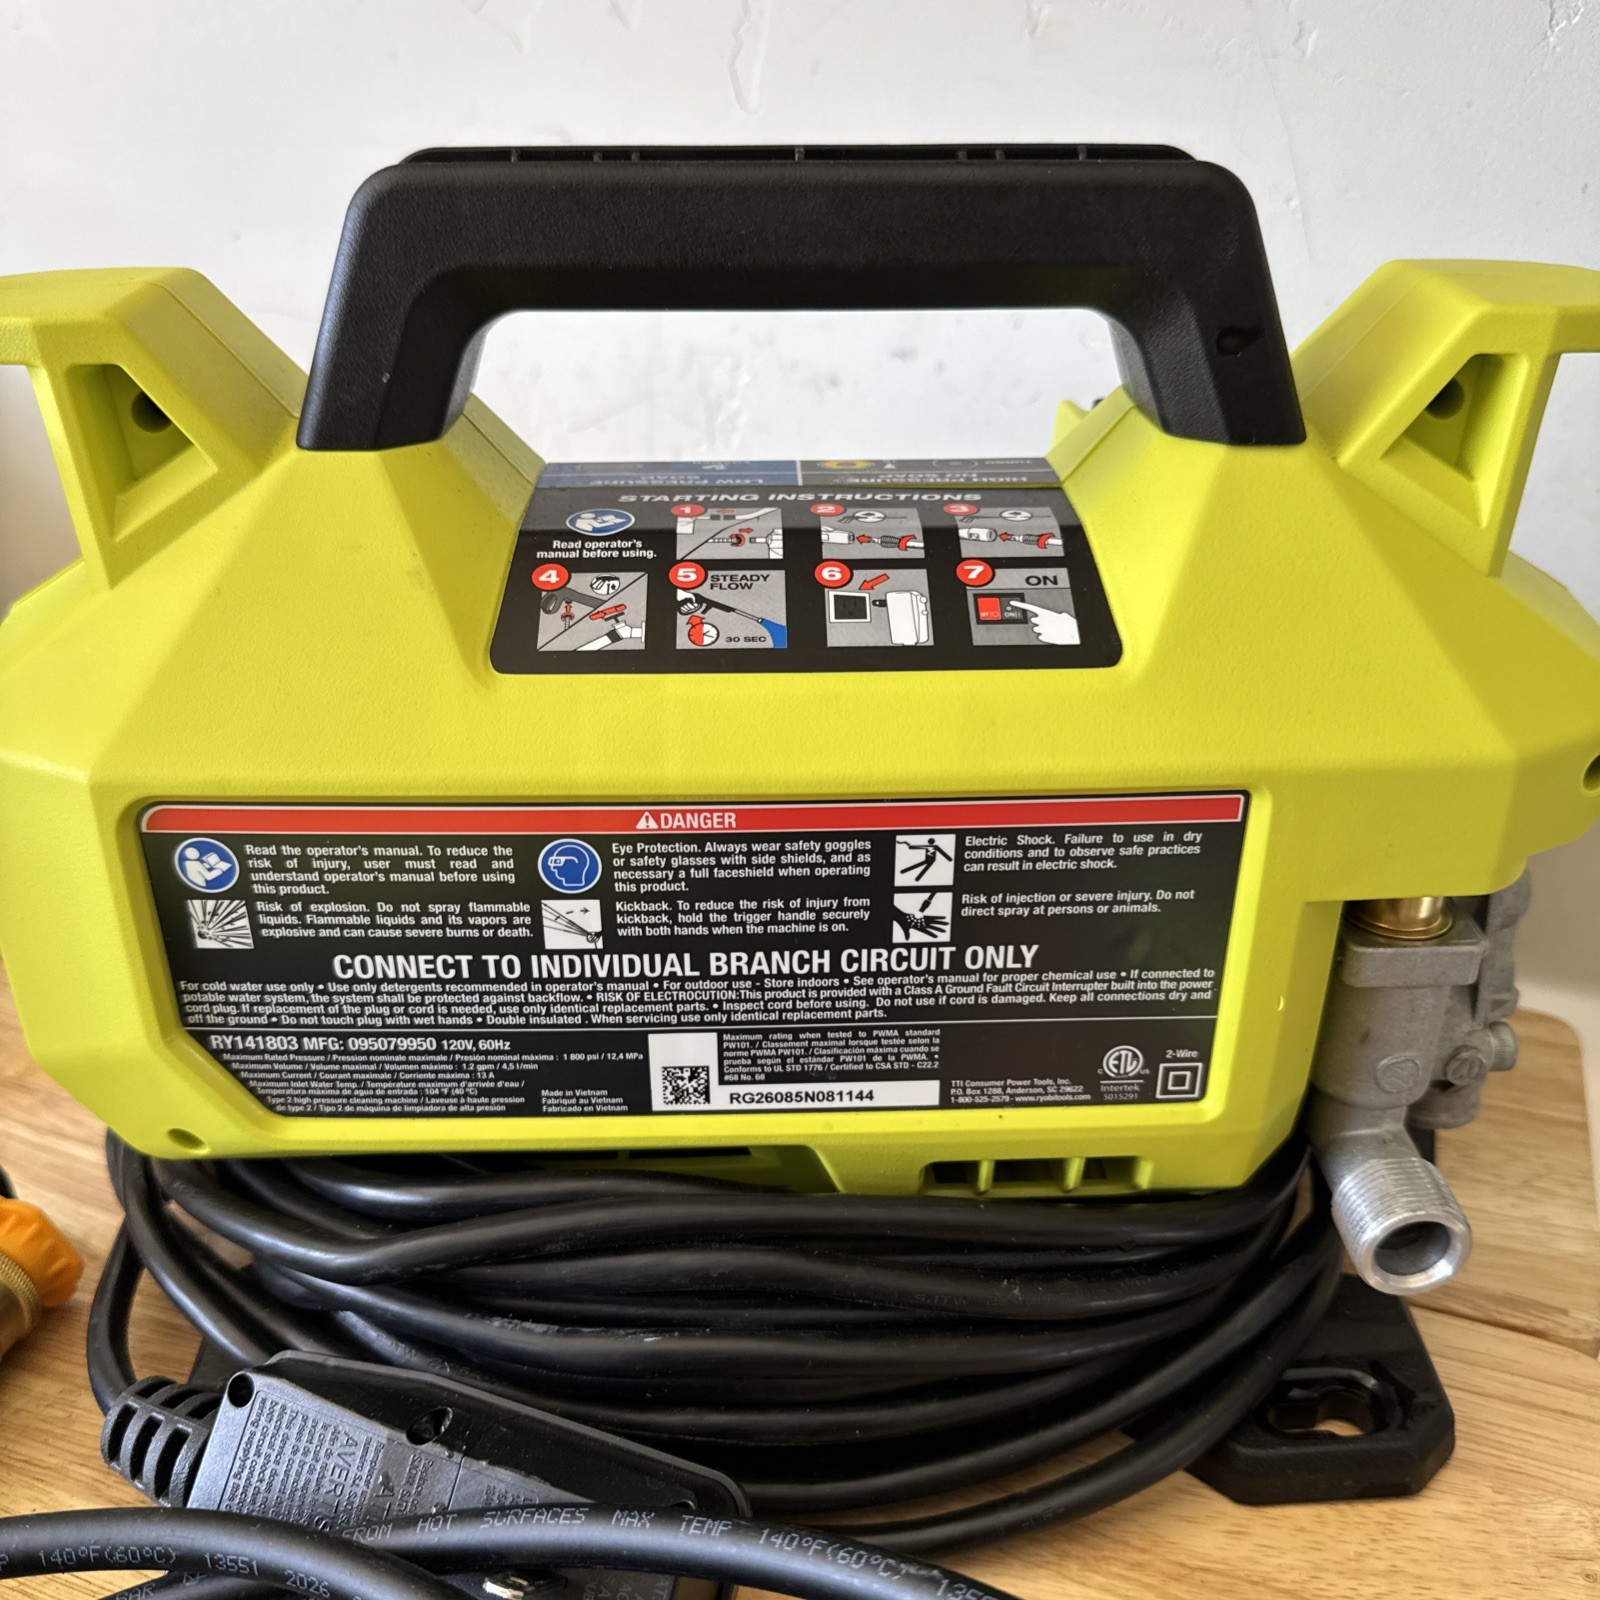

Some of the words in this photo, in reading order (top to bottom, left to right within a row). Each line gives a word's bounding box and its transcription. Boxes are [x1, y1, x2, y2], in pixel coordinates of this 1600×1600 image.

[618, 494, 759, 502] STARTING
[768, 493, 981, 501] INSTRUCTIONS
[680, 505, 693, 515] 1
[816, 505, 836, 514] 2
[950, 505, 969, 514] 3
[552, 540, 582, 549] Read
[584, 540, 642, 552] operator's
[536, 550, 579, 558] manual
[582, 549, 619, 558] before
[622, 549, 656, 559] using.
[538, 570, 560, 584] 4
[677, 568, 697, 582] 5
[710, 574, 770, 583] STEADY
[822, 568, 842, 582] 6
[964, 566, 984, 579] 7
[710, 582, 754, 590] FLOW
[1025, 576, 1058, 586] ON
[660, 813, 737, 830] DANGER
[965, 836, 1007, 846] Electric
[1016, 834, 1055, 845] Shock.
[1064, 833, 1103, 844] Failure
[1112, 833, 1124, 843] to
[1132, 834, 1154, 842] use
[1162, 832, 1174, 842] in
[1182, 831, 1202, 843] dry
[245, 845, 277, 855] Read
[280, 845, 301, 856] the
[306, 845, 369, 858] operator's
[373, 846, 422, 856] manual.
[426, 846, 441, 856] To
[446, 846, 488, 856] reduce
[492, 846, 512, 856] the
[964, 848, 1023, 859] conditions
[1027, 847, 1049, 858] and
[1053, 847, 1065, 857] to
[1069, 846, 1115, 857] observe
[1118, 845, 1144, 856] safe
[1147, 844, 1200, 857] practices
[247, 858, 272, 868] risk
[285, 858, 298, 868] of
[312, 858, 350, 871] injury,
[363, 861, 390, 869] user
[404, 859, 436, 869] must
[449, 859, 477, 869] read
[491, 859, 514, 869] and
[963, 863, 984, 872] can
[987, 861, 1020, 871] result
[1022, 860, 1033, 870] in
[1035, 859, 1077, 870] electric
[1079, 858, 1117, 869] shock.
[250, 871, 319, 881] understand
[323, 871, 385, 884] operator's
[389, 872, 434, 882] manual
[438, 871, 477, 882] before
[482, 872, 515, 884] using
[252, 884, 276, 894] this
[278, 884, 329, 896] product.
[615, 901, 672, 912] Kickback.
[676, 900, 690, 911] To
[694, 900, 734, 910] reduce
[738, 899, 757, 909] the
[762, 899, 784, 909] risk
[789, 898, 801, 908] of
[806, 898, 838, 910] injury
[843, 897, 870, 907] from
[616, 913, 672, 925] kickback,
[678, 913, 703, 923] hold
[708, 912, 727, 922] the
[733, 911, 772, 924] trigger
[777, 910, 816, 921] handle
[822, 909, 870, 921] securely
[616, 926, 642, 936] with
[645, 926, 671, 936] both
[673, 925, 709, 935] hands
[711, 925, 743, 935] when
[745, 924, 764, 934] the
[767, 923, 816, 933] machine
[818, 922, 828, 932] is
[831, 924, 848, 932] on.
[333, 953, 473, 980] CONNECT
[481, 954, 521, 978] TO
[530, 952, 700, 977] INDIVIDUAL
[709, 949, 830, 974] BRANCH
[840, 946, 956, 972] CIRCUIT
[964, 944, 1039, 969] ONLY
[188, 1014, 203, 1023] off
[205, 1014, 225, 1024] the
[227, 1014, 268, 1026] ground
[280, 1015, 297, 1024] Do
[299, 1016, 319, 1025] not
[320, 1015, 354, 1025] touch
[356, 1013, 382, 1027] plug
[384, 1013, 410, 1025] with
[412, 1016, 435, 1025] wet
[437, 1015, 473, 1025] hands
[486, 1015, 526, 1025] Double
[529, 1013, 581, 1024] insulated
[590, 1012, 622, 1024] When
[625, 1013, 677, 1025] servicing
[680, 1014, 700, 1022] use
[703, 1012, 728, 1024] only
[730, 1009, 779, 1021] identical
[782, 1009, 852, 1022] replacement
[854, 1007, 887, 1020] parts.
[210, 1035, 299, 1050] RY141803
[302, 1037, 344, 1050] MFG:
[347, 1037, 436, 1051] 095079950
[441, 1040, 476, 1052] 120V,
[478, 1039, 511, 1050] 60Hz
[1166, 1050, 1198, 1058] 2-Wire
[1033, 1078, 1055, 1086] Tools,
[1100, 1084, 1140, 1092] Intertek
[729, 1089, 874, 1105] RG26085N081144
[342, 1523, 392, 1541] FROM
[416, 1514, 458, 1534] HOT
[480, 1508, 589, 1528] SURFACES
[611, 1509, 655, 1528] MAX
[680, 1514, 732, 1536] TEMP
[204, 1552, 260, 1576] 13551
[285, 1570, 330, 1597] 2026
